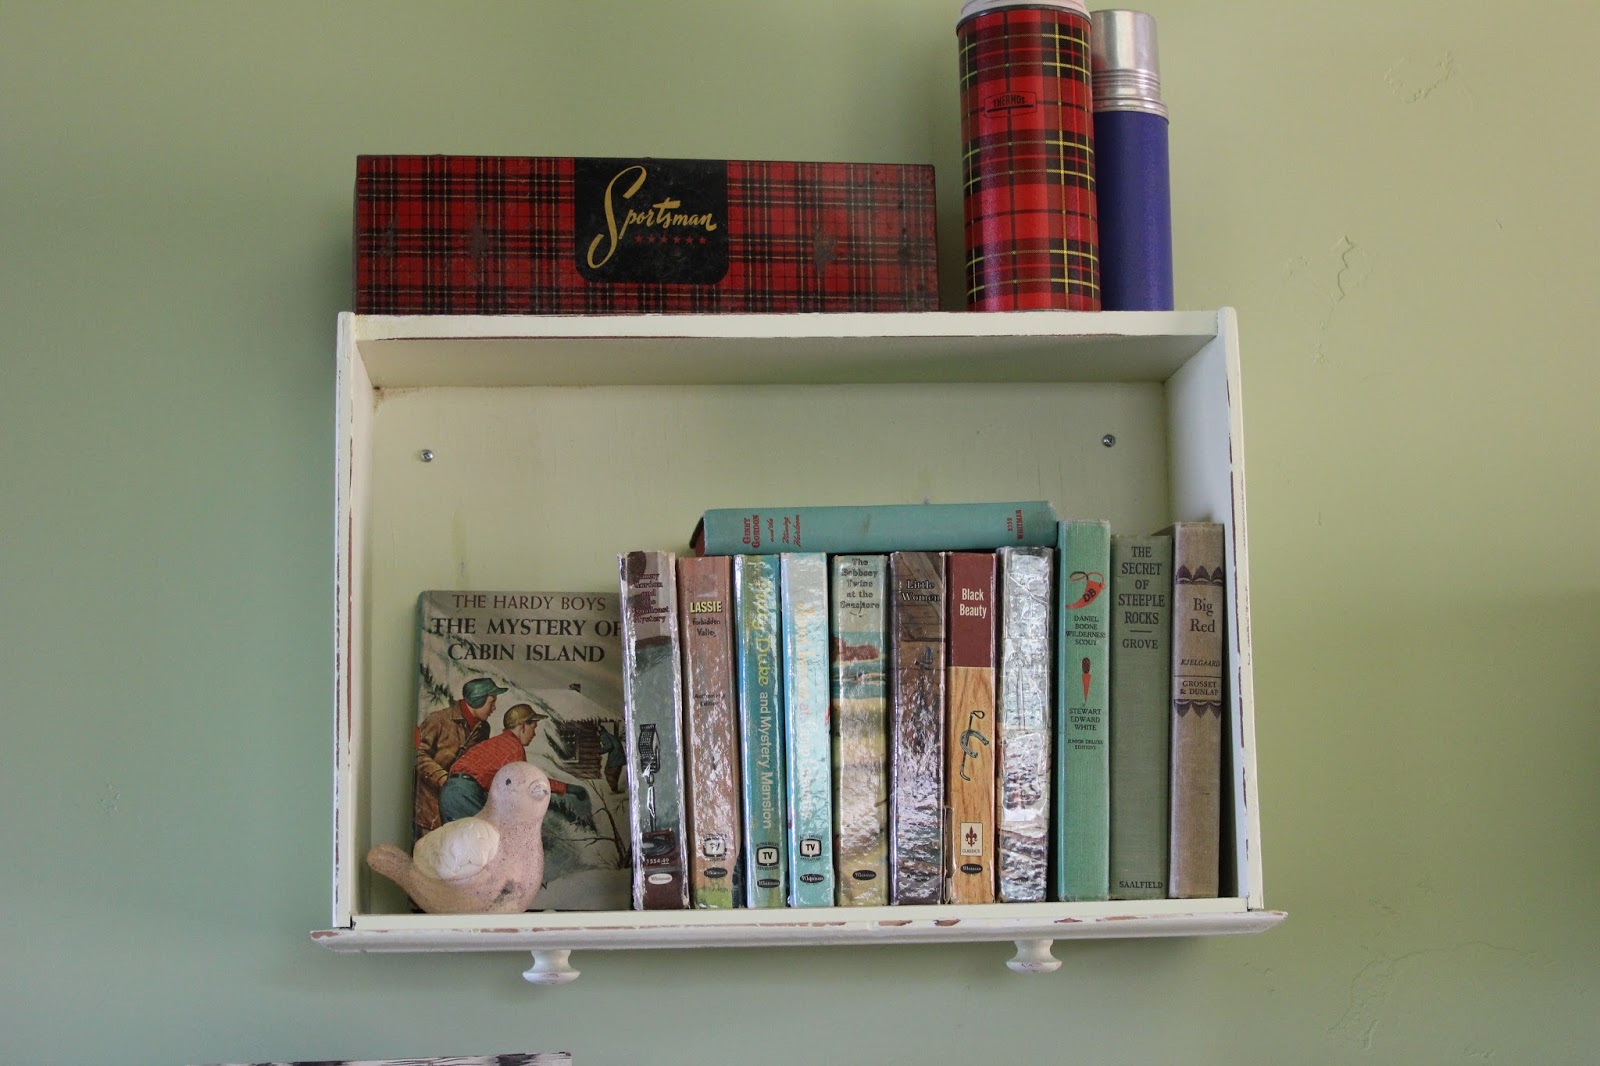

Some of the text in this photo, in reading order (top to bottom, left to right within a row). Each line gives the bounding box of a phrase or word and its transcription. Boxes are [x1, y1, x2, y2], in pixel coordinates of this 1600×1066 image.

[993, 94, 1026, 107] THERMOS
[587, 165, 717, 269] Sportsman
[1131, 546, 1152, 558] THE
[852, 558, 868, 566] The
[1121, 562, 1162, 576] SECRET
[846, 579, 873, 588] Twins
[906, 580, 935, 590] Little
[1134, 579, 1150, 590] OF
[859, 590, 873, 598] the
[901, 592, 941, 602] Women
[961, 588, 984, 601] Black
[1118, 593, 1165, 607] STEEPLE
[452, 594, 606, 612] THE HARDY BOYS
[689, 601, 722, 613] LASSIE
[1193, 597, 1214, 616] Big
[959, 603, 987, 619] Beauty
[1073, 615, 1099, 623] DANIEL
[1124, 611, 1159, 625] ROCKS
[431, 617, 476, 635] THE
[486, 618, 587, 637] MYSTERY
[1189, 618, 1215, 633] Red
[1122, 638, 1158, 650] GROVE
[447, 643, 605, 663] CABIN ISLAND
[755, 636, 771, 686] Duke
[1182, 680, 1217, 688] GROSSET
[1188, 688, 1219, 696] DUNLAP
[759, 692, 771, 714] and
[757, 716, 772, 768] Mystery
[762, 771, 774, 829] Mansion
[763, 852, 773, 860] TV
[1119, 881, 1163, 889] SAALFIELD
